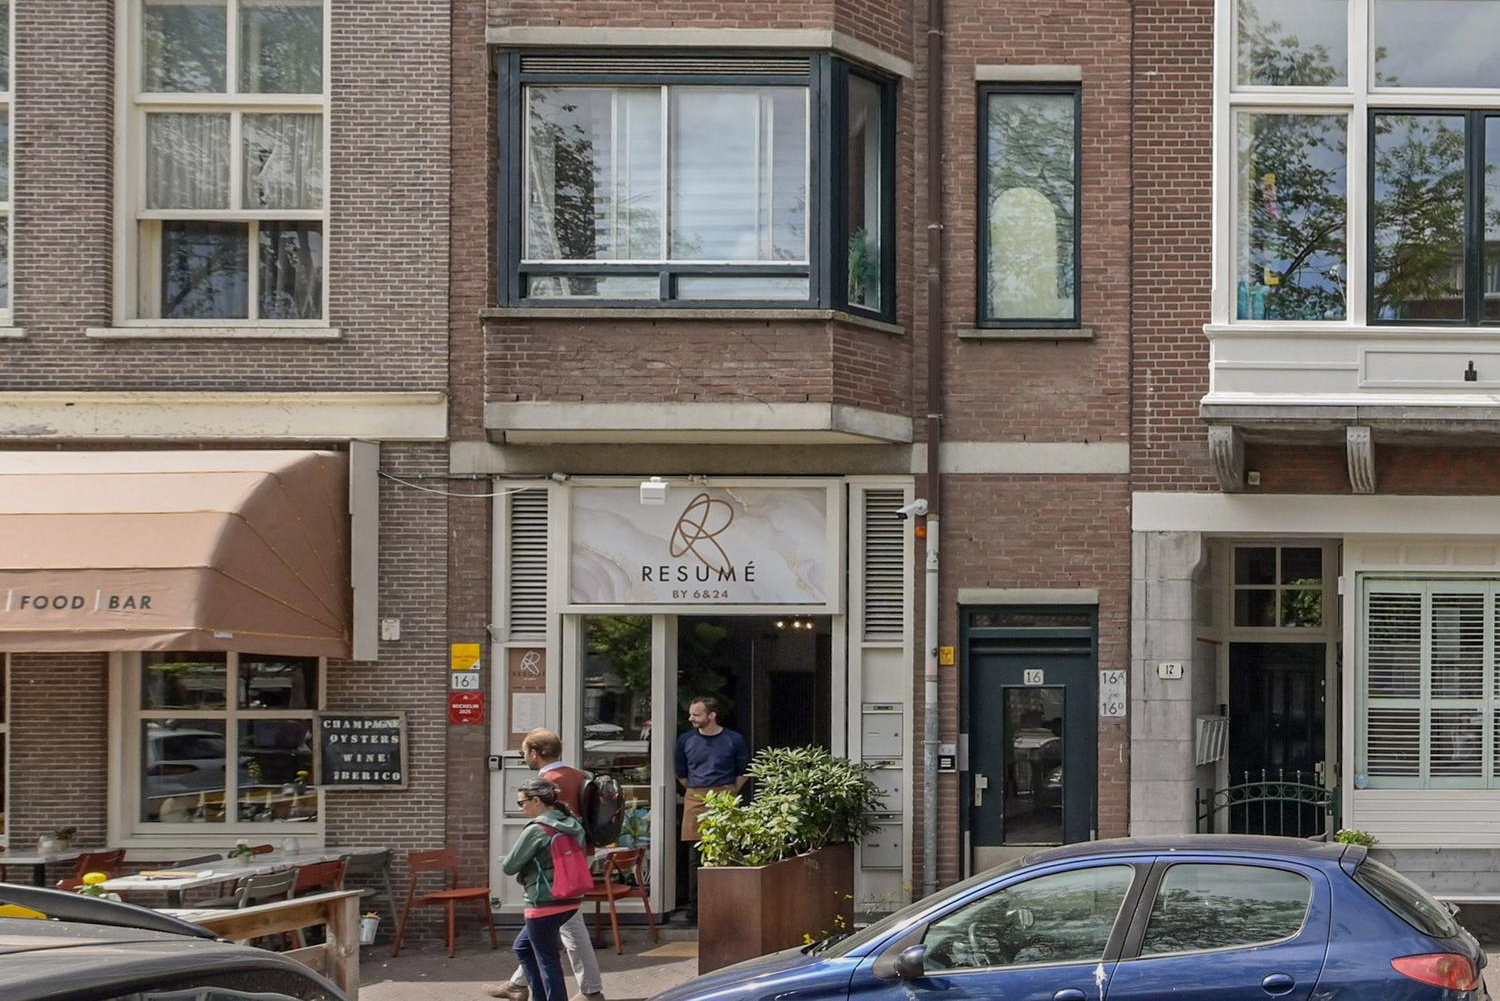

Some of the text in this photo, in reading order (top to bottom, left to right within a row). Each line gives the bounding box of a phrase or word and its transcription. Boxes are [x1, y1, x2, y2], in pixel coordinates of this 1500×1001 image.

[641, 561, 756, 583] RESUMÉ
[672, 590, 729, 599] BY 6&24
[20, 595, 152, 610] FOOD BAR
[1165, 664, 1175, 676] 17
[1026, 671, 1042, 684] 16
[323, 719, 401, 729] CHAMPAGNE
[329, 734, 399, 745] OYSTERS
[343, 754, 386, 763] WINE
[333, 770, 401, 781] IBERICO
